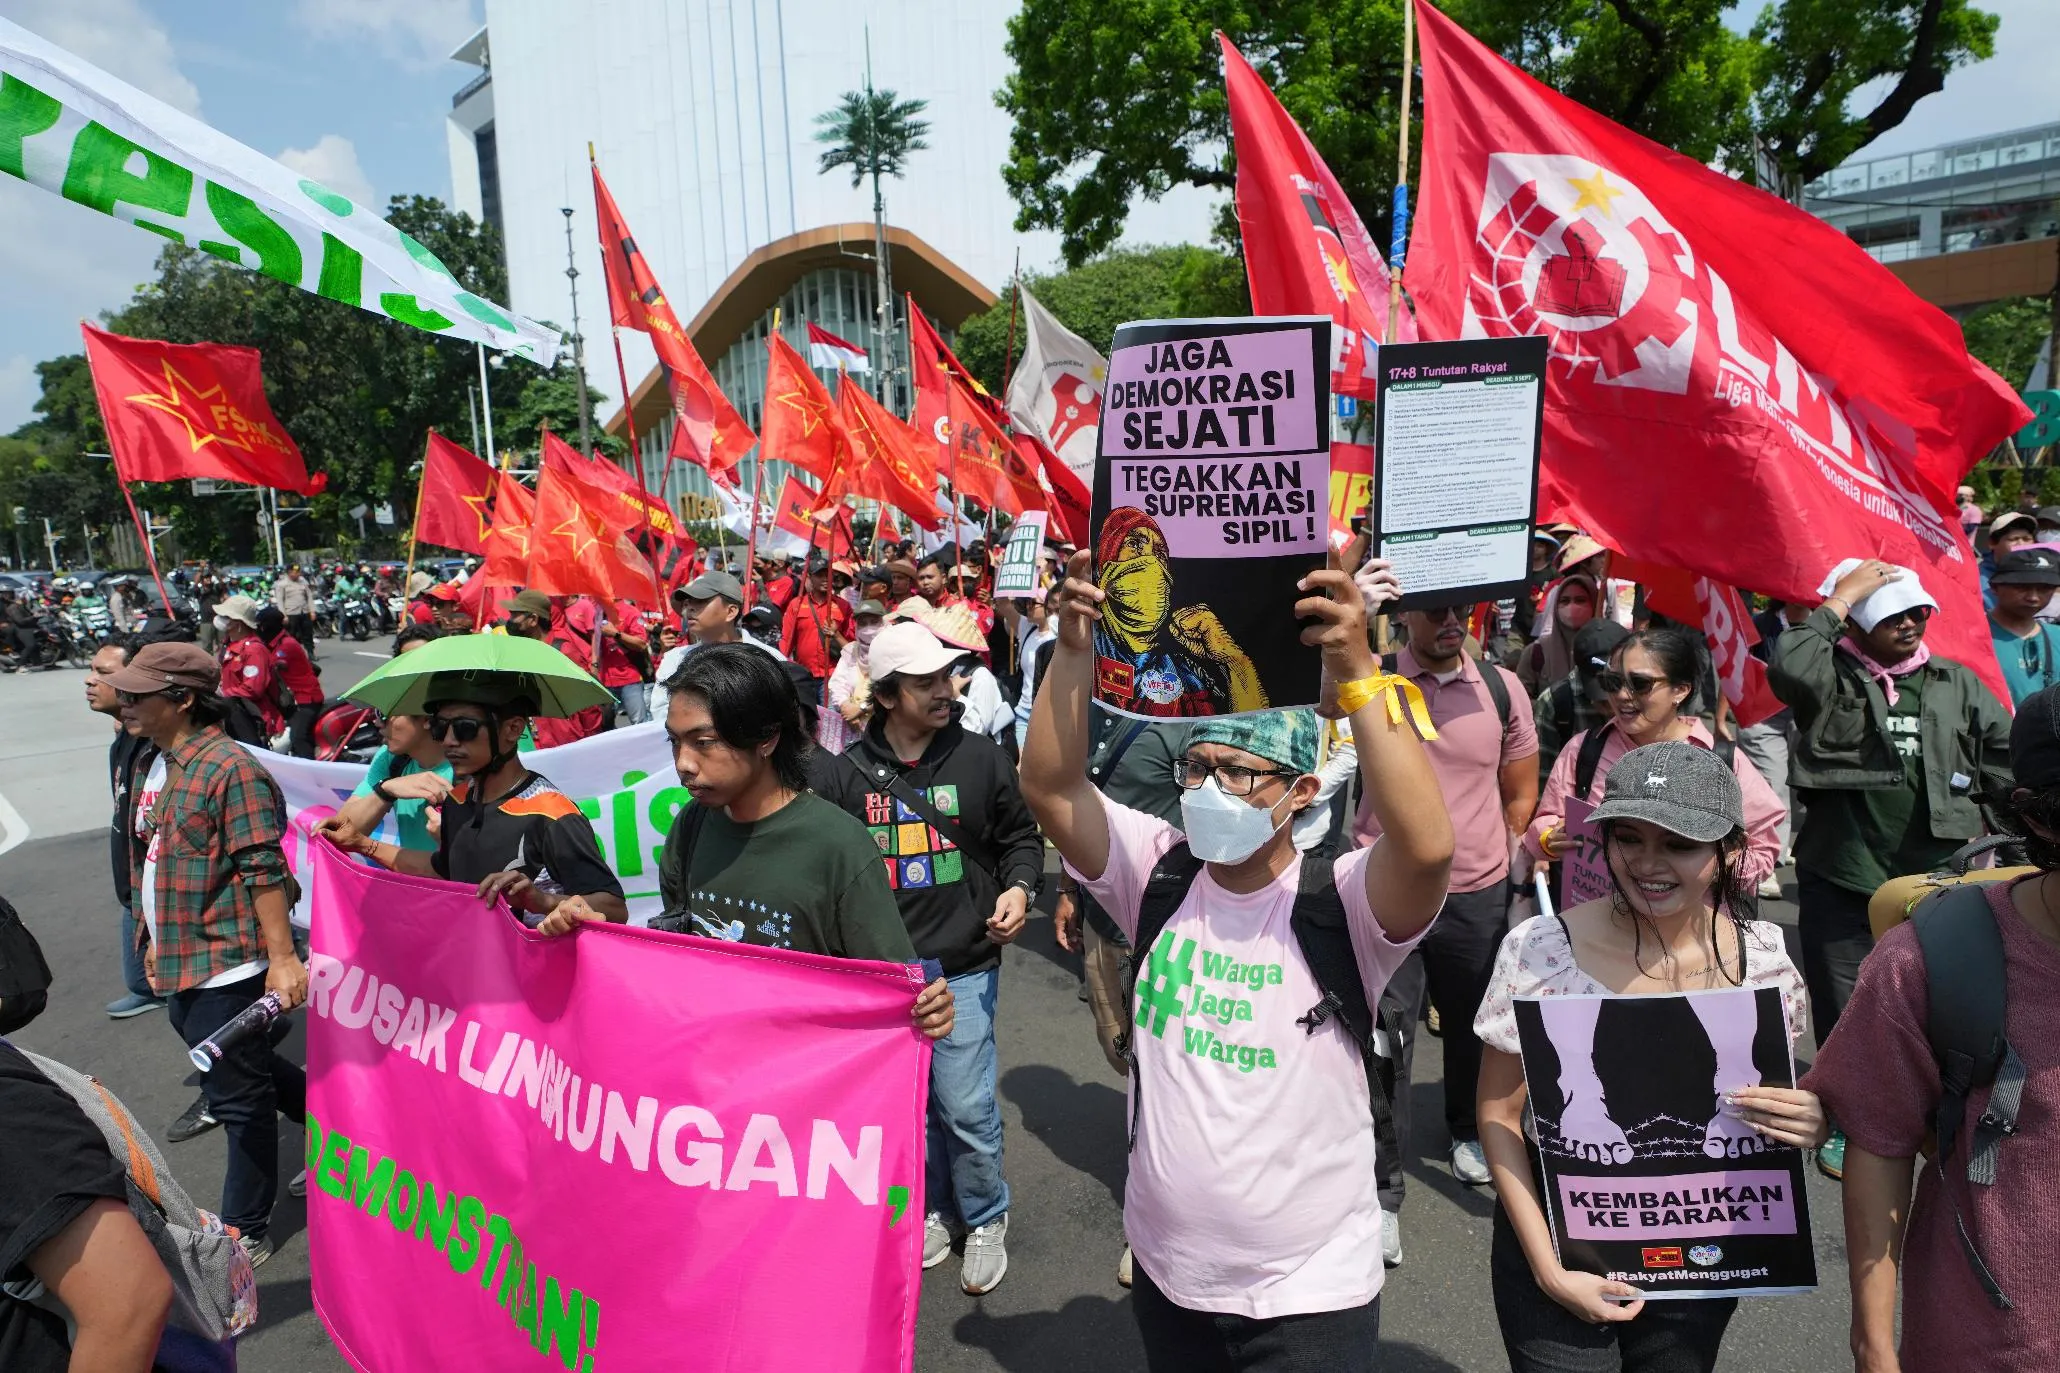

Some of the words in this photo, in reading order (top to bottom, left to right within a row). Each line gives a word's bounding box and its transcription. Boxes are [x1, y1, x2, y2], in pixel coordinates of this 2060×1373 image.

[1144, 338, 1233, 373] JAGA
[1389, 366, 1417, 380] 17+8
[1421, 364, 1467, 377] Tuntutan
[1471, 361, 1507, 374] Rakyat
[1111, 369, 1295, 410] DEMOKRASI
[1392, 382, 1413, 391] DALAM
[1416, 381, 1440, 390] MINGGU
[1123, 404, 1276, 450] SEJATI
[1714, 370, 1752, 407] Liga
[1864, 491, 1902, 525] untuk
[1122, 460, 1302, 492] TEGAKKAN
[1144, 490, 1316, 518] SUPREMASI
[1223, 520, 1298, 545] SIPIL
[1307, 520, 1315, 541] !
[1391, 535, 1411, 543] DALAM
[1414, 533, 1434, 541] TAHUN
[1469, 527, 1496, 535] DEADLINE:
[756, 924, 780, 938] adams
[764, 919, 776, 930] the
[1202, 950, 1283, 991] Warga
[307, 951, 457, 1073] RUSAK
[1187, 984, 1252, 1025] Jaga
[1184, 1026, 1277, 1073] Warga
[1569, 1185, 1784, 1210] KEMBALIKAN
[1588, 1209, 1628, 1228] KE
[1641, 1205, 1752, 1227] BARAK
[1762, 1204, 1770, 1221] !
[305, 1111, 599, 1373] DEMONSTRAN!
[1606, 1266, 1769, 1283] #RakyatMenggugat
